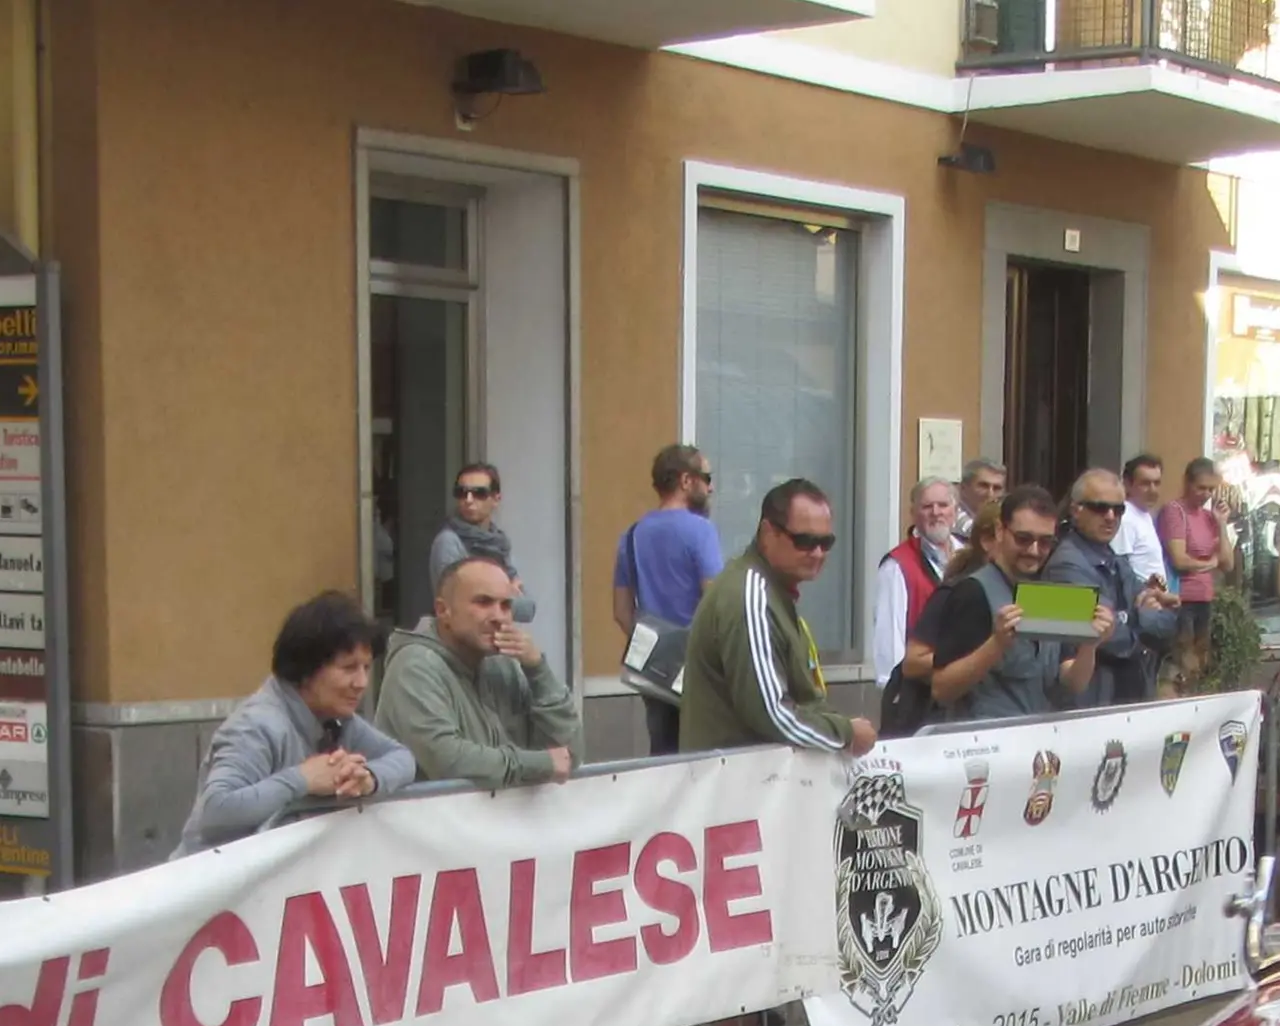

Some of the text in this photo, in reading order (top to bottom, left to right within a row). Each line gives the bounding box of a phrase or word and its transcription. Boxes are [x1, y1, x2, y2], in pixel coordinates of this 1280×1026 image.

[949, 843, 983, 859] COMUNE DI
[951, 858, 984, 873] CAVALESE
[949, 835, 1248, 939] MONTAGNE D'ARGENTO
[1014, 945, 1042, 967] Gara
[1043, 940, 1056, 960] di
[1057, 925, 1113, 959] regolarità
[1116, 924, 1137, 948] per
[1140, 916, 1166, 937] auto
[1057, 999, 1097, 1026] Valle
[1099, 989, 1114, 1017] di
[1117, 978, 1170, 1011] Fiemme
